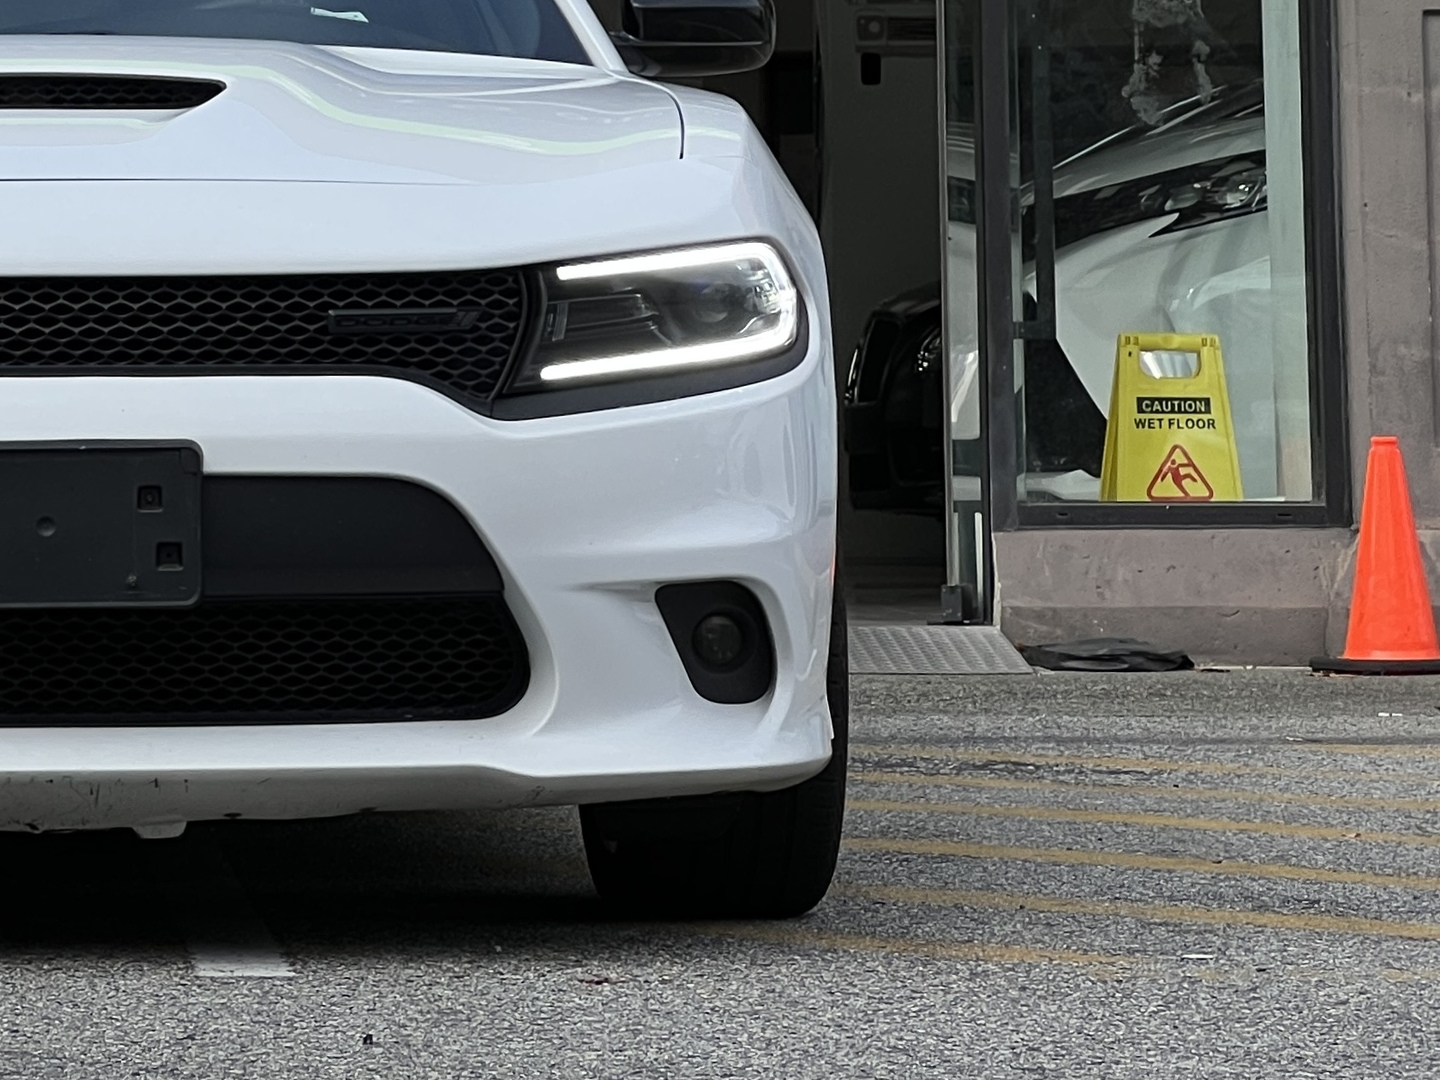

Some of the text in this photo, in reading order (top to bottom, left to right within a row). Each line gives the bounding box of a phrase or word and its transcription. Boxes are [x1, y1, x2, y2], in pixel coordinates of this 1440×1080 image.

[1141, 400, 1206, 412] CAUTION
[1134, 418, 1216, 430] WET FLOOR
